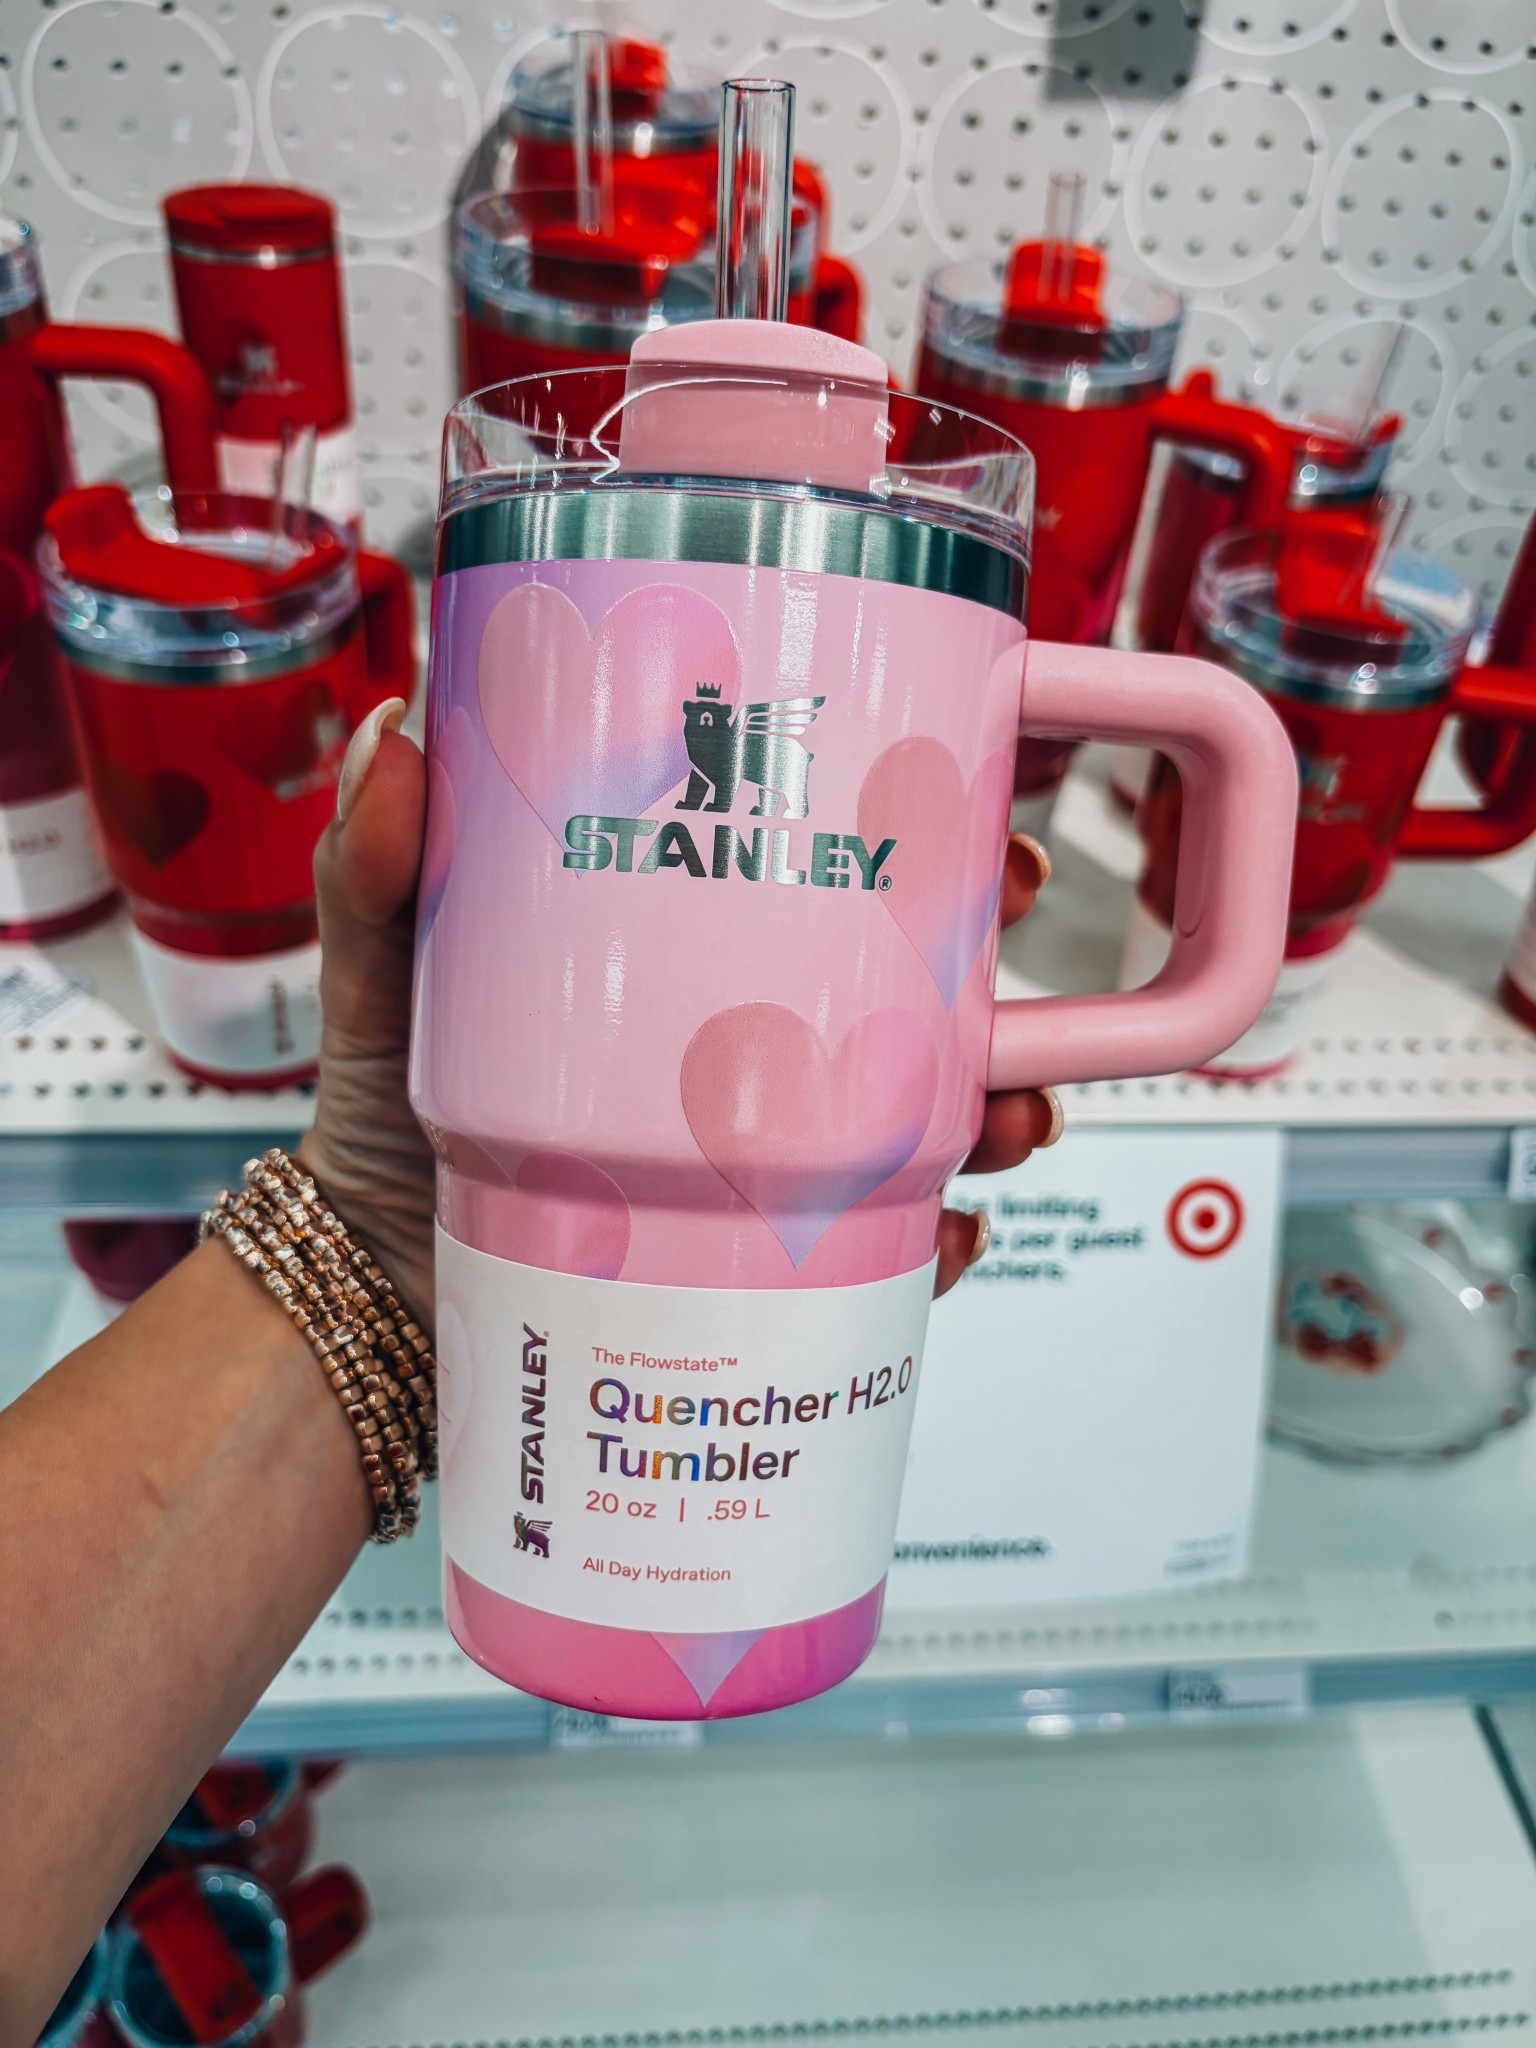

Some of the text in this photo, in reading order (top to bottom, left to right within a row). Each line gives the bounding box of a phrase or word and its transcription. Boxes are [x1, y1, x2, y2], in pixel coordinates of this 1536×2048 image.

[591, 1346, 625, 1365] The
[589, 1355, 913, 1427] Quencher H2.0
[586, 1431, 800, 1482] Tumbler
[585, 1489, 619, 1514] 20
[626, 1501, 657, 1519] oz
[707, 1499, 747, 1520] .59
[755, 1498, 770, 1519] L
[582, 1556, 731, 1583] All Day Hydration
